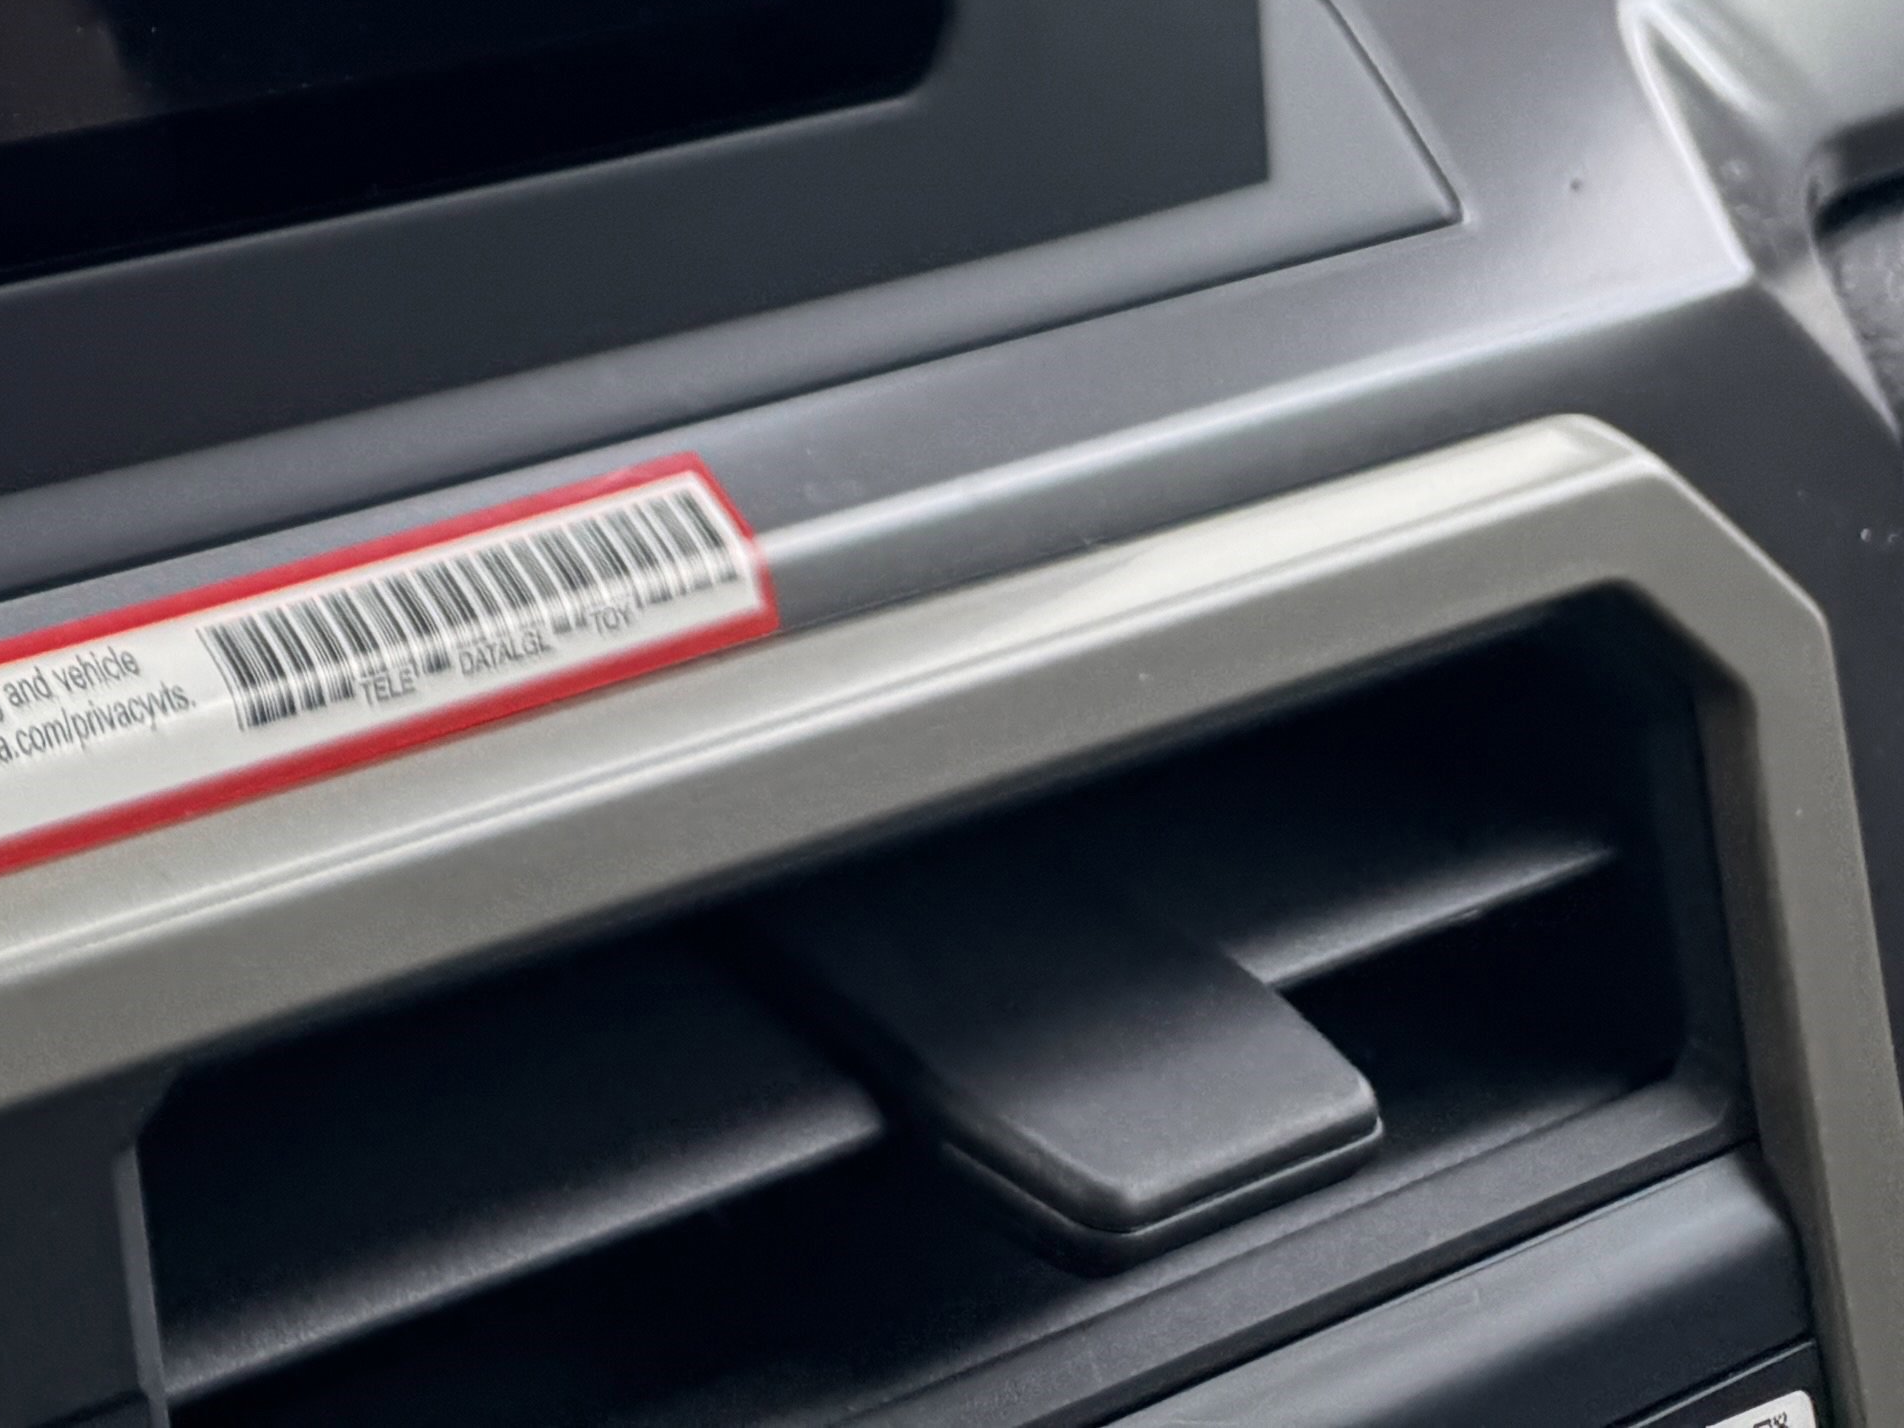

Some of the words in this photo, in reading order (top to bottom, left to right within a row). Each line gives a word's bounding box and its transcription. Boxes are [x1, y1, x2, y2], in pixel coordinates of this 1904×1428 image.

[3, 666, 53, 708] and
[52, 646, 140, 694] vehicle
[358, 667, 416, 707] TELE
